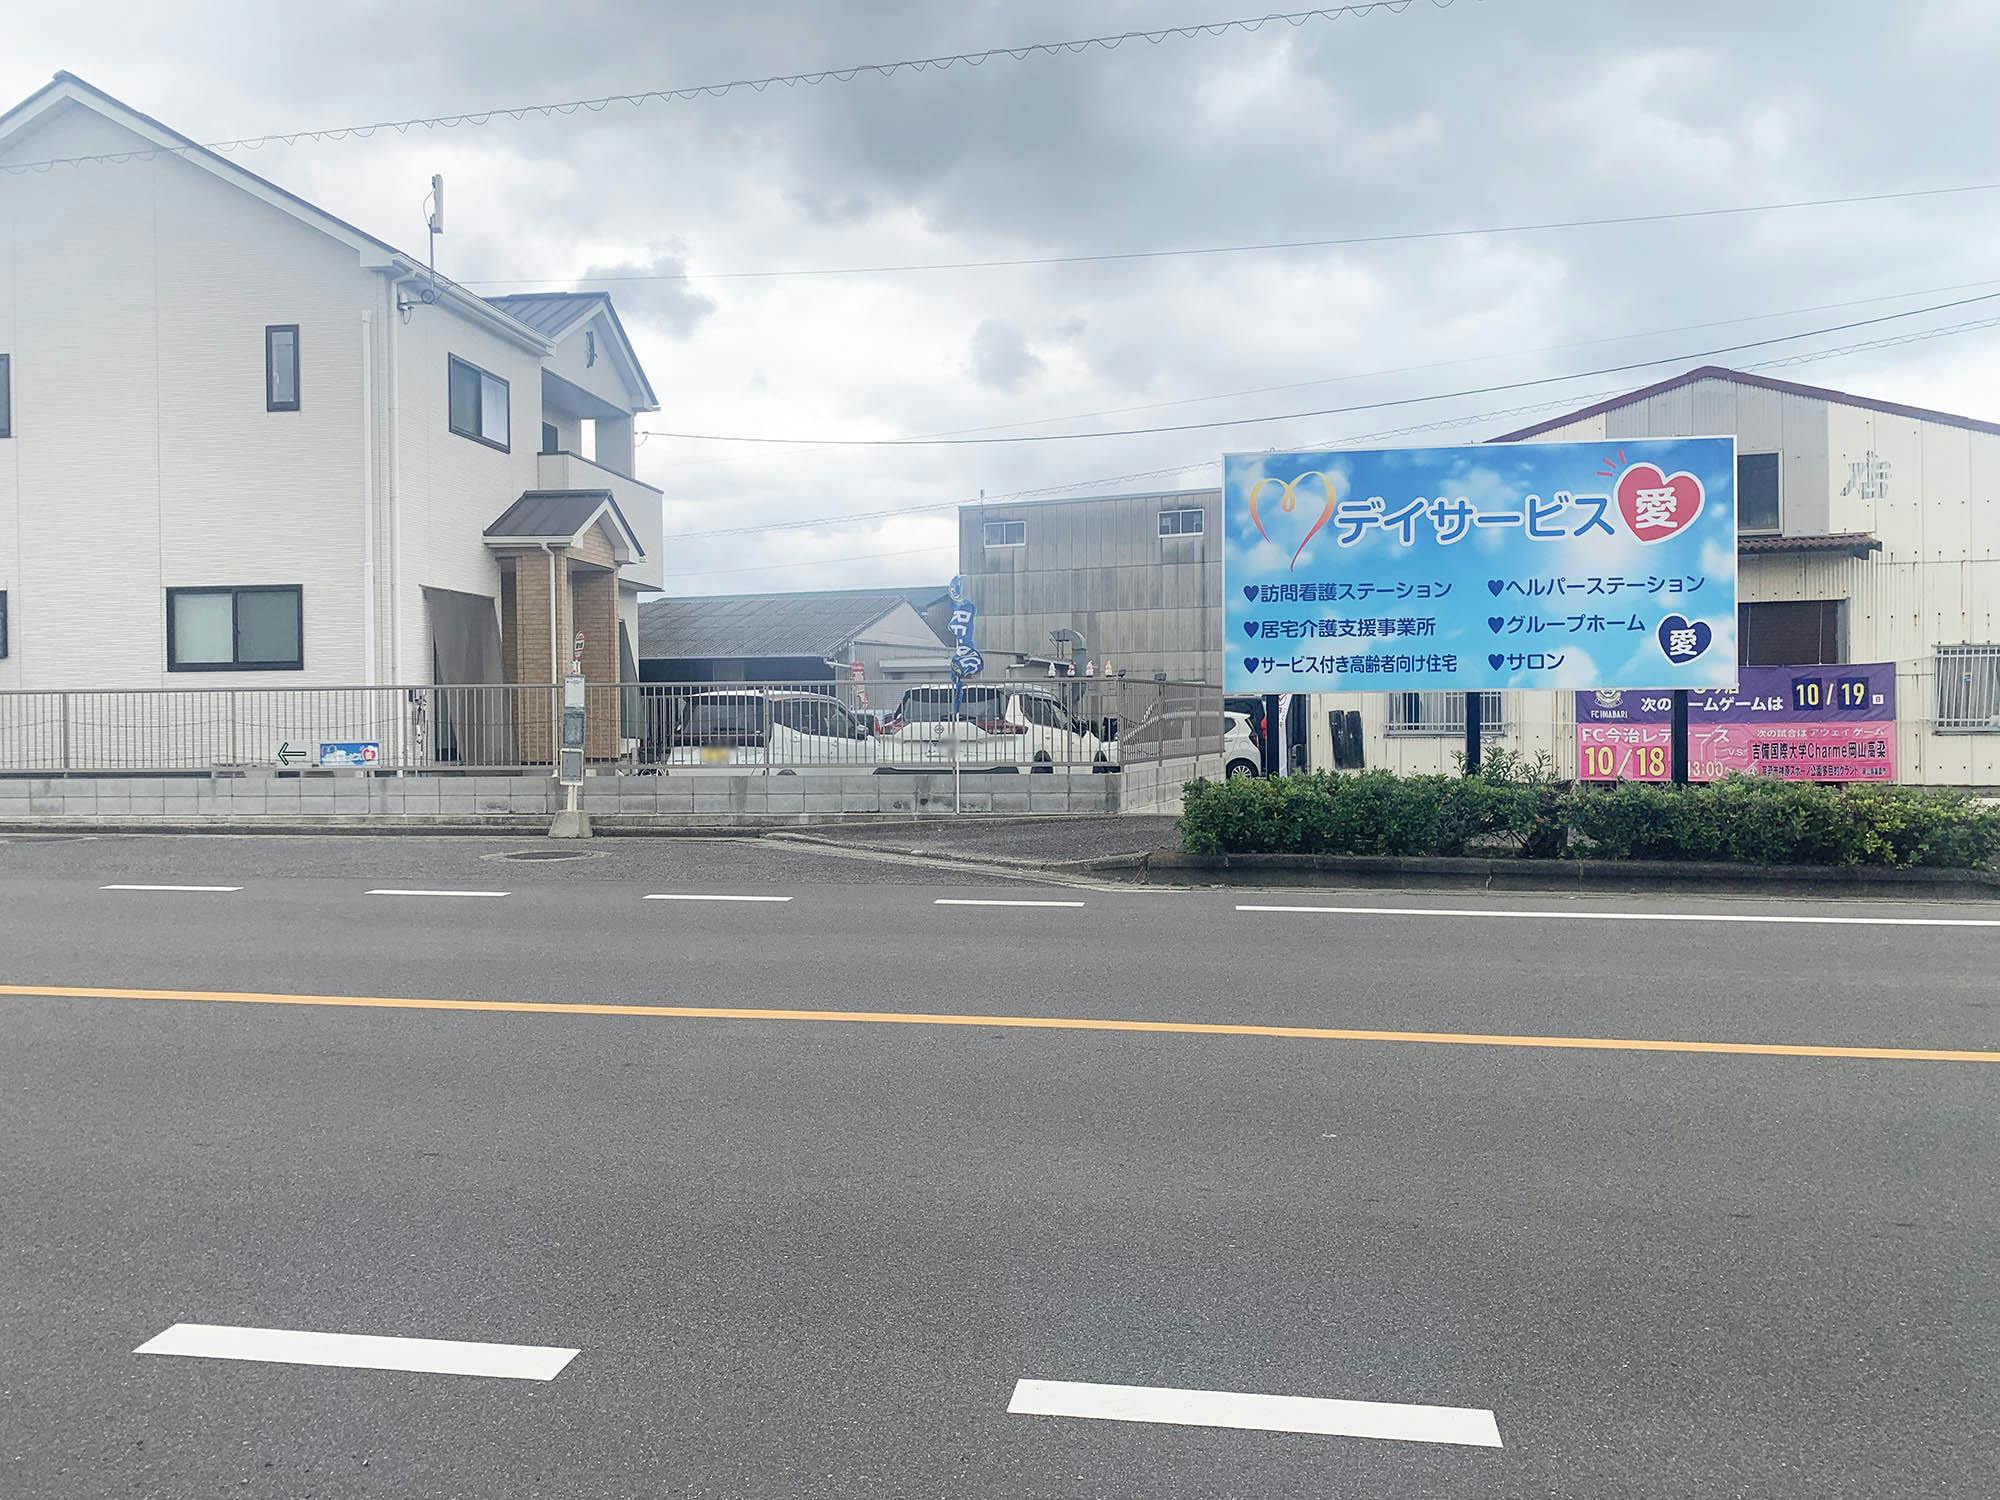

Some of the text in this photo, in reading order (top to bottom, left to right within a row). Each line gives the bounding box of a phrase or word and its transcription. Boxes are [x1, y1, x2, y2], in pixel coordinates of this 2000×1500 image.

[1335, 486, 1678, 545] デイサービス 愛
[1260, 581, 1452, 602] 訪問看護ステーション
[1506, 576, 1705, 596] ヘルパーステーション
[1260, 618, 1436, 639] 居宅介護支援事業所
[1506, 614, 1645, 633] グループホーム
[1669, 629, 1697, 657] 愛
[1260, 654, 1457, 674] サービス付き高齢者向け住宅
[1507, 653, 1564, 671] サロン
